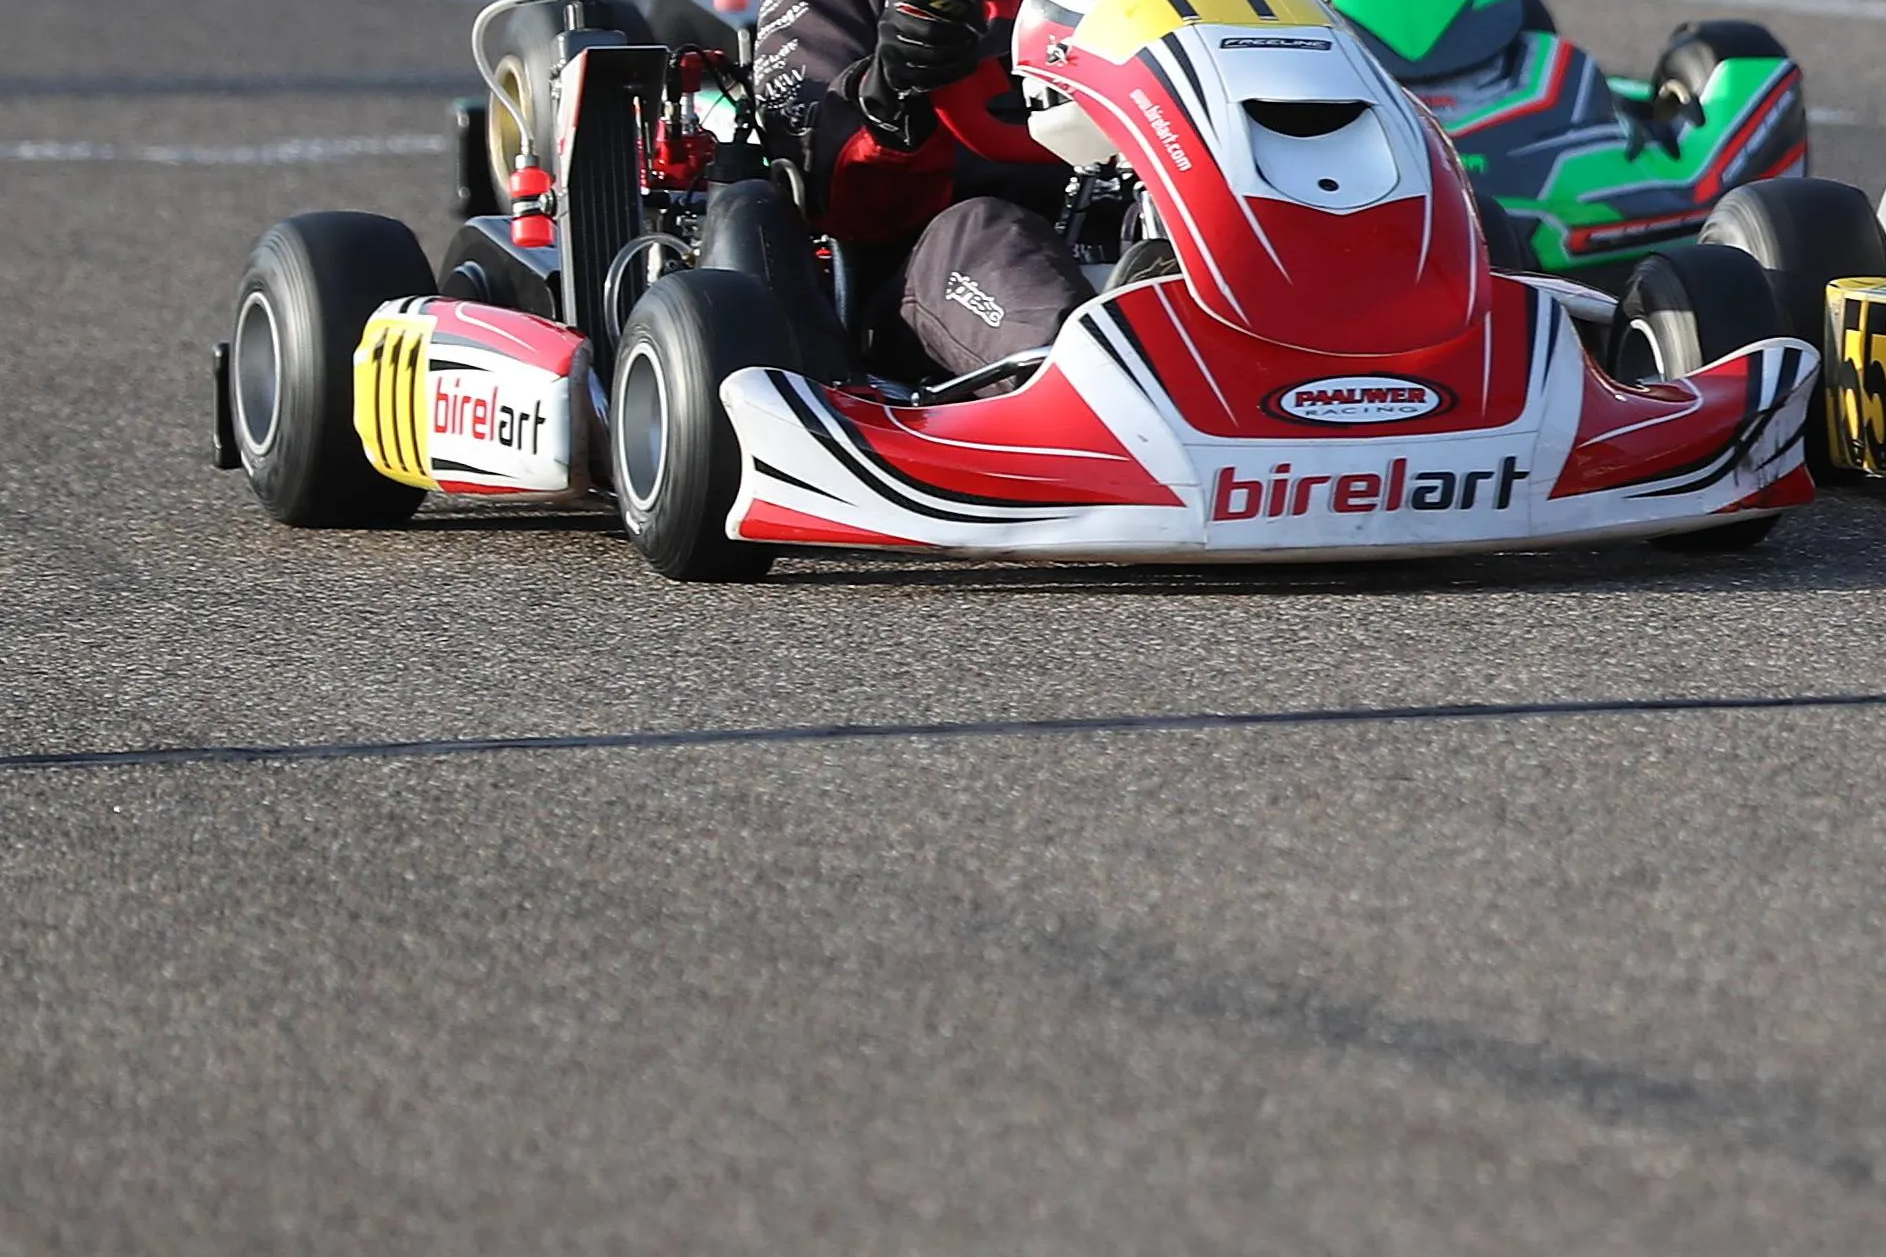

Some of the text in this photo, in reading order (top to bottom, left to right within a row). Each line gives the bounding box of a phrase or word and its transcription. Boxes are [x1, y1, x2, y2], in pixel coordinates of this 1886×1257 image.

[372, 327, 428, 477] 111
[434, 376, 546, 456] birelart
[1304, 405, 1420, 417] RACING
[1211, 455, 1530, 522] birelart
